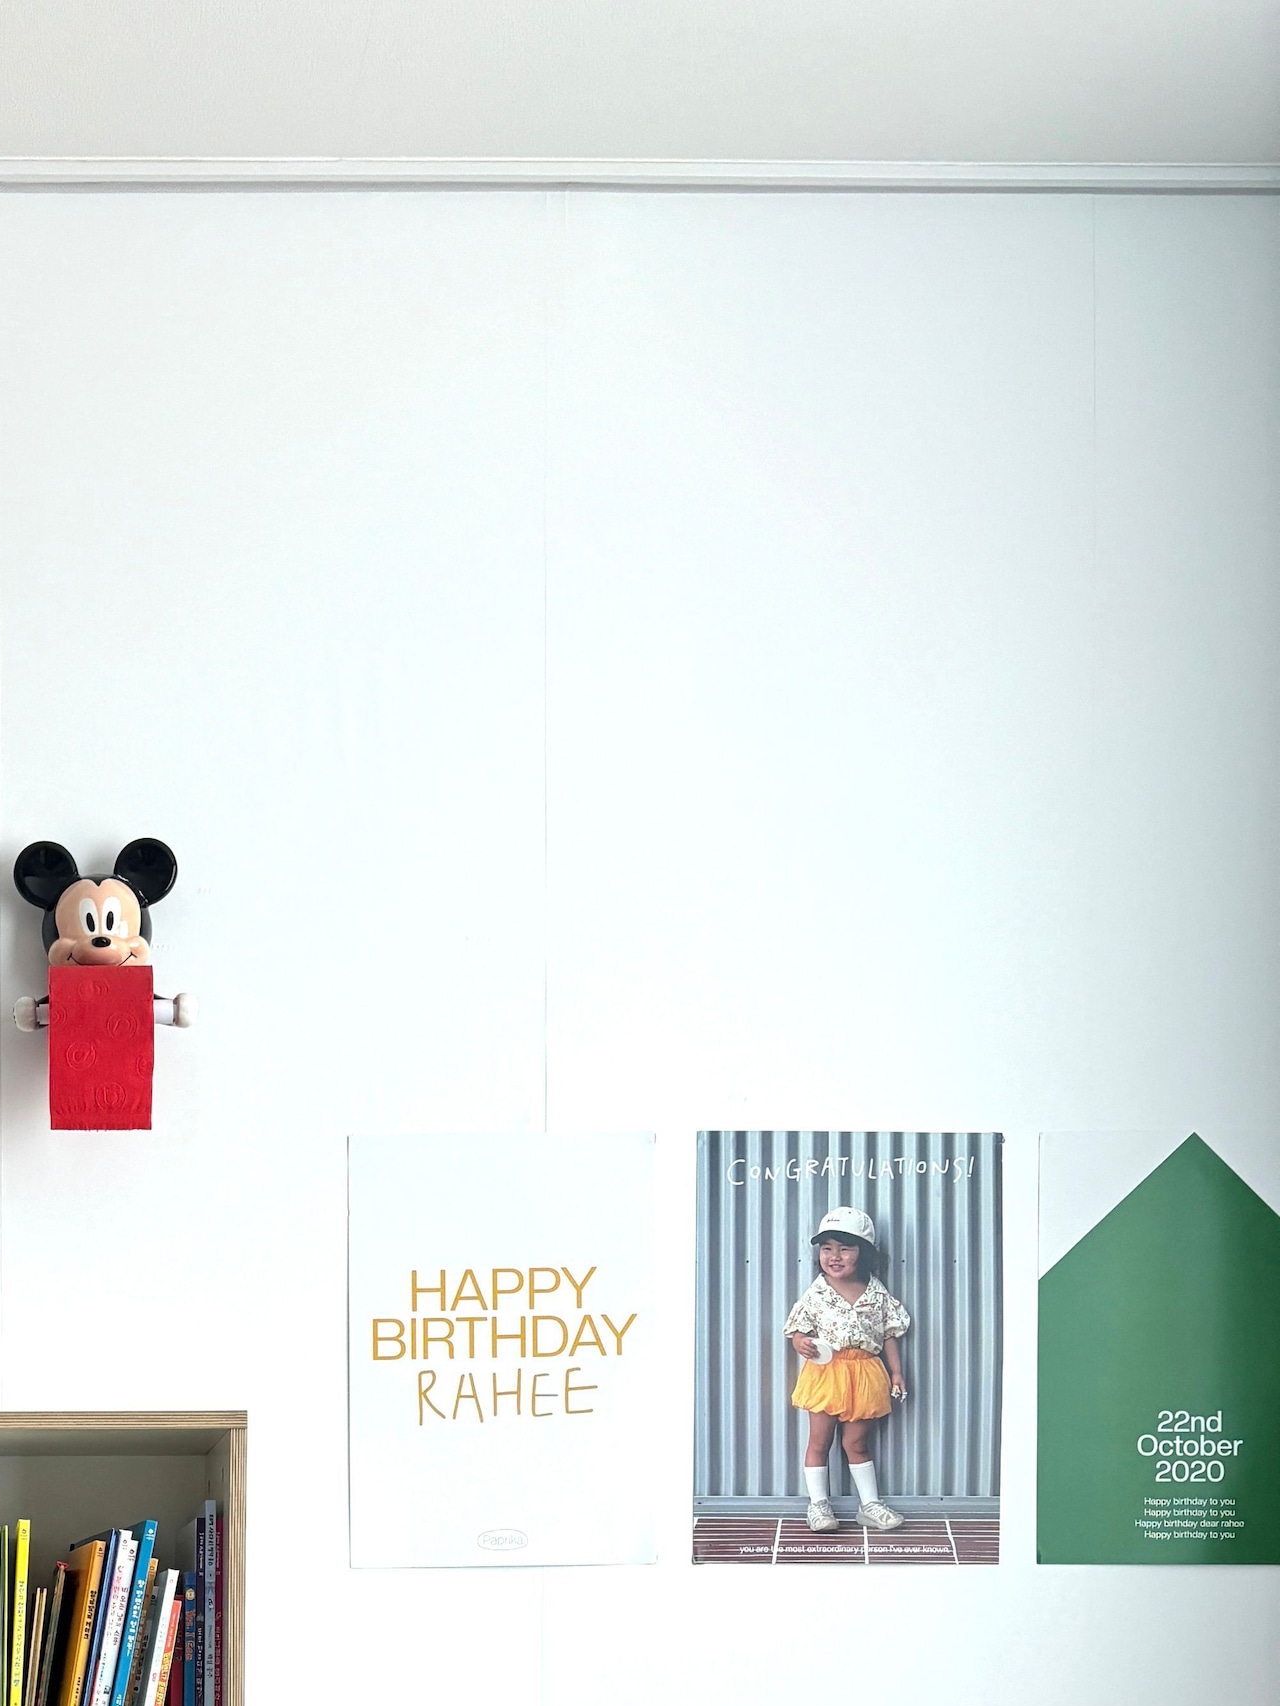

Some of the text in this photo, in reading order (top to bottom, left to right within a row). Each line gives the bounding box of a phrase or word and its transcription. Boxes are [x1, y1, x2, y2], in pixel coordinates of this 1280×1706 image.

[727, 1156, 975, 1186] CONGRATULATIONS!
[412, 1266, 598, 1312] HAPPY
[372, 1313, 638, 1361] BIRTHDAY
[418, 1367, 599, 1427] RAHEE
[1157, 1410, 1222, 1432] 22nd
[1137, 1434, 1244, 1456] October
[1155, 1460, 1225, 1483] 2020
[1144, 1497, 1236, 1506] Happy birthday to you
[1134, 1519, 1162, 1529] Happy
[1164, 1519, 1198, 1529] birthday
[1200, 1519, 1218, 1527] dear
[1144, 1508, 1236, 1518] Happy birthday to you
[483, 1534, 524, 1546] Paprika
[1144, 1531, 1236, 1540] Happy birthday to you
[806, 1546, 858, 1554] extraordinary
